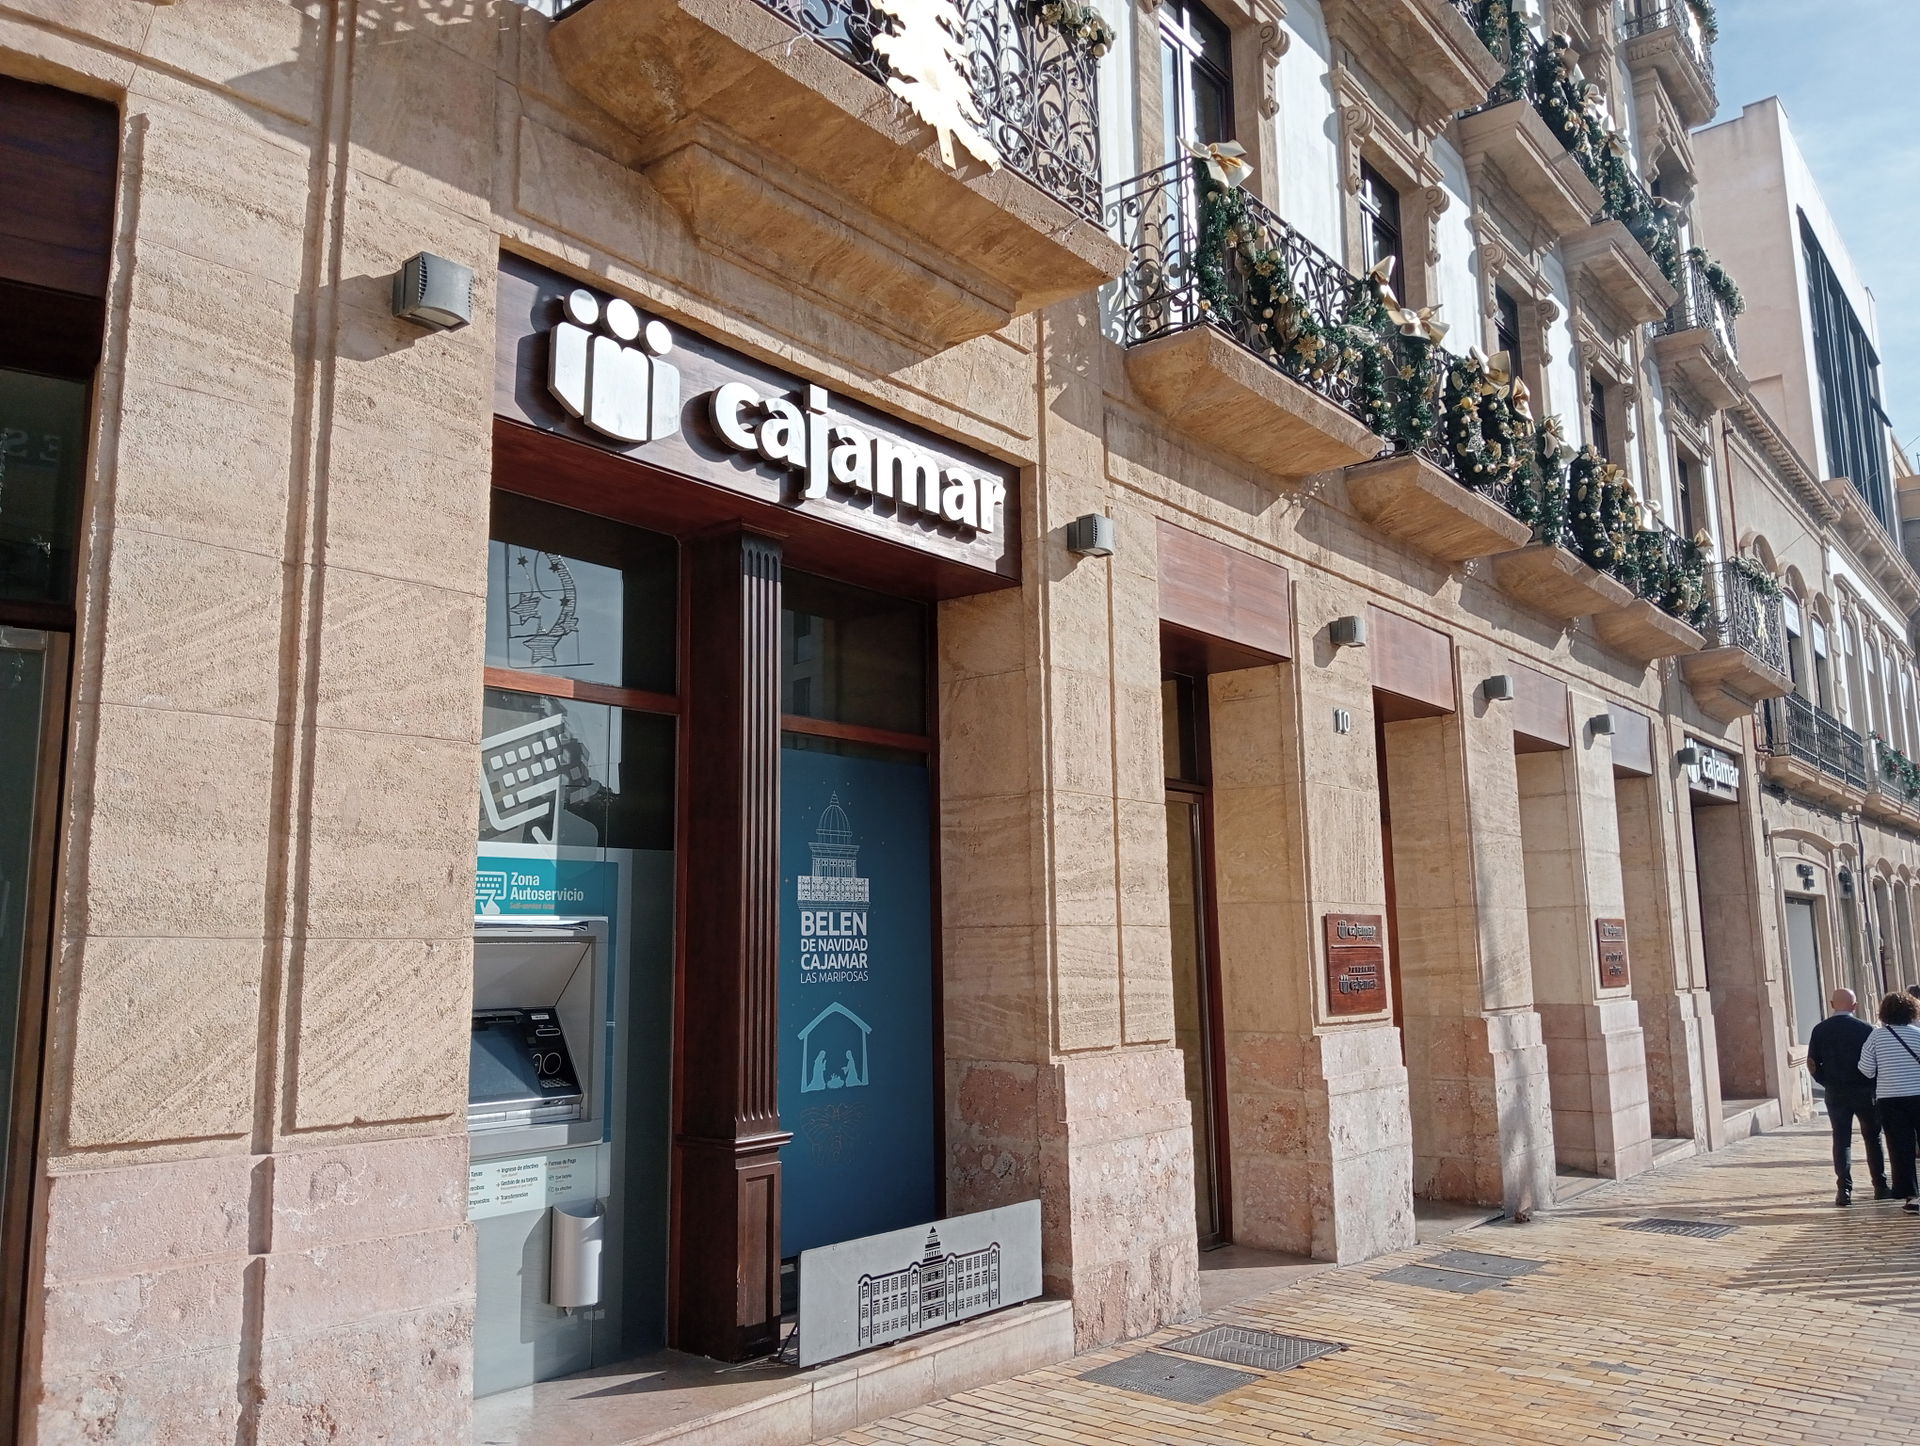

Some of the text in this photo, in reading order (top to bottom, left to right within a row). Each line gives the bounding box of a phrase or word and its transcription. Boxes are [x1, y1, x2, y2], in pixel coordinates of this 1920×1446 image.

[709, 383, 1006, 534] cajamar
[1337, 709, 1350, 731] 10
[1702, 749, 1740, 790] cajamar
[510, 872, 540, 886] Zona
[510, 887, 584, 902] Autoservicio
[801, 911, 867, 936] BELEN
[801, 938, 869, 952] DE NAVIDAD
[801, 953, 869, 971] CAJAMAR
[800, 970, 869, 984] LAS MARIPOSAS
